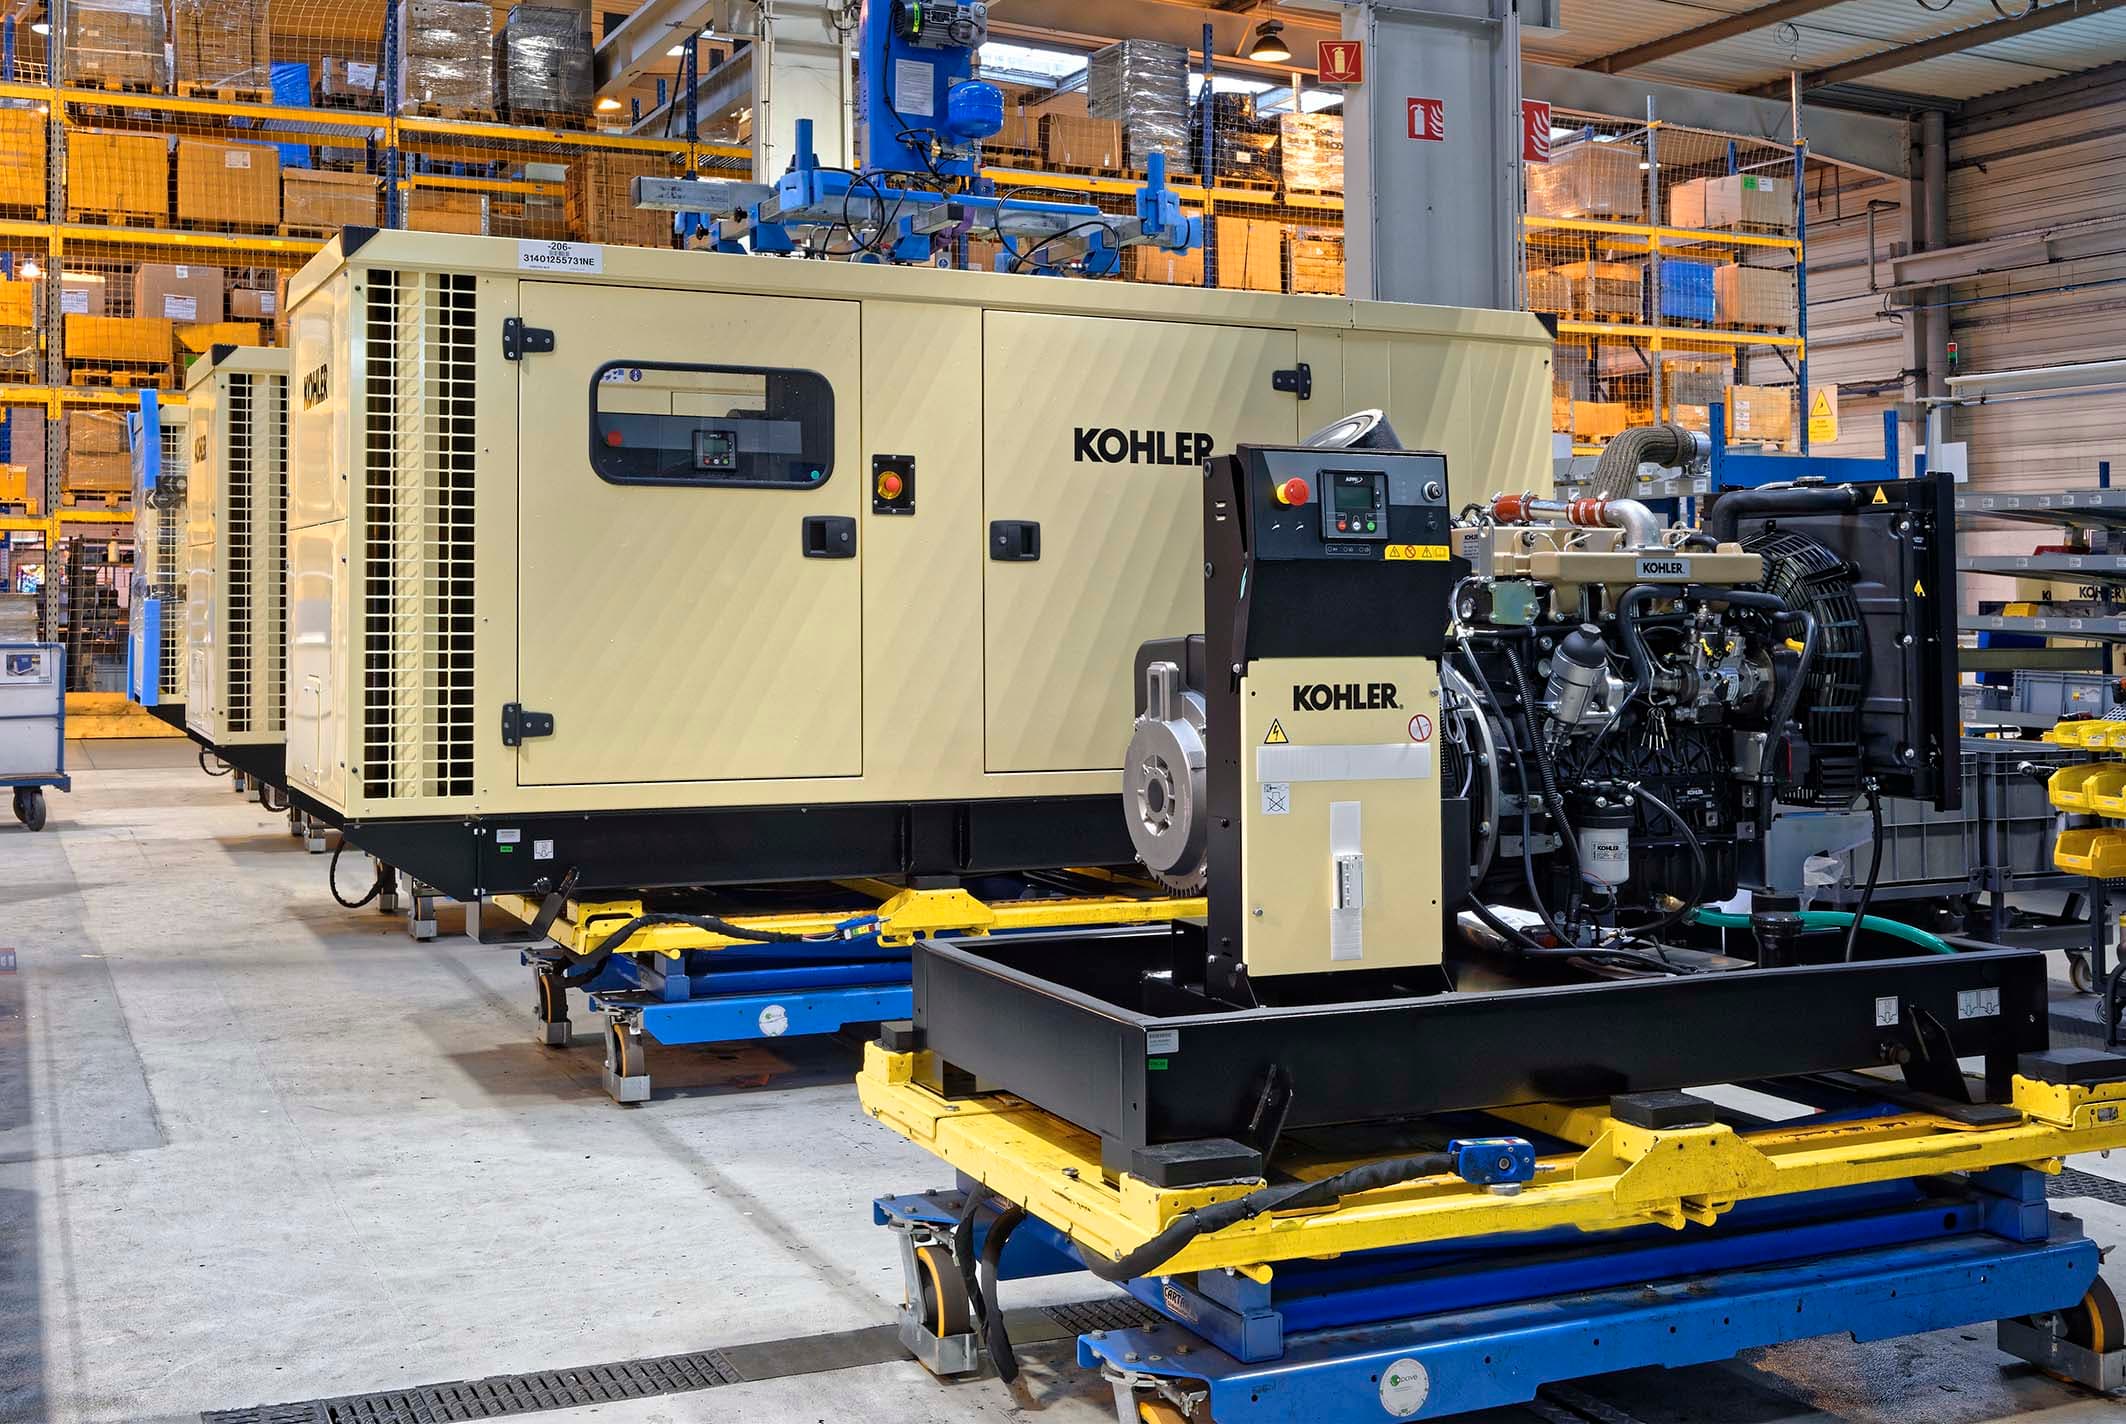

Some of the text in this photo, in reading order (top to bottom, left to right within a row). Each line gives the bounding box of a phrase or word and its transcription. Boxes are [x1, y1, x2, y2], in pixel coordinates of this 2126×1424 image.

[548, 242, 572, 251] -206-
[523, 254, 595, 266] 31401255731NE
[304, 363, 328, 411] KOHLER
[1074, 428, 1214, 466] KOHLER
[1643, 562, 1683, 574] KOHLER
[1293, 683, 1399, 711] KOHLER
